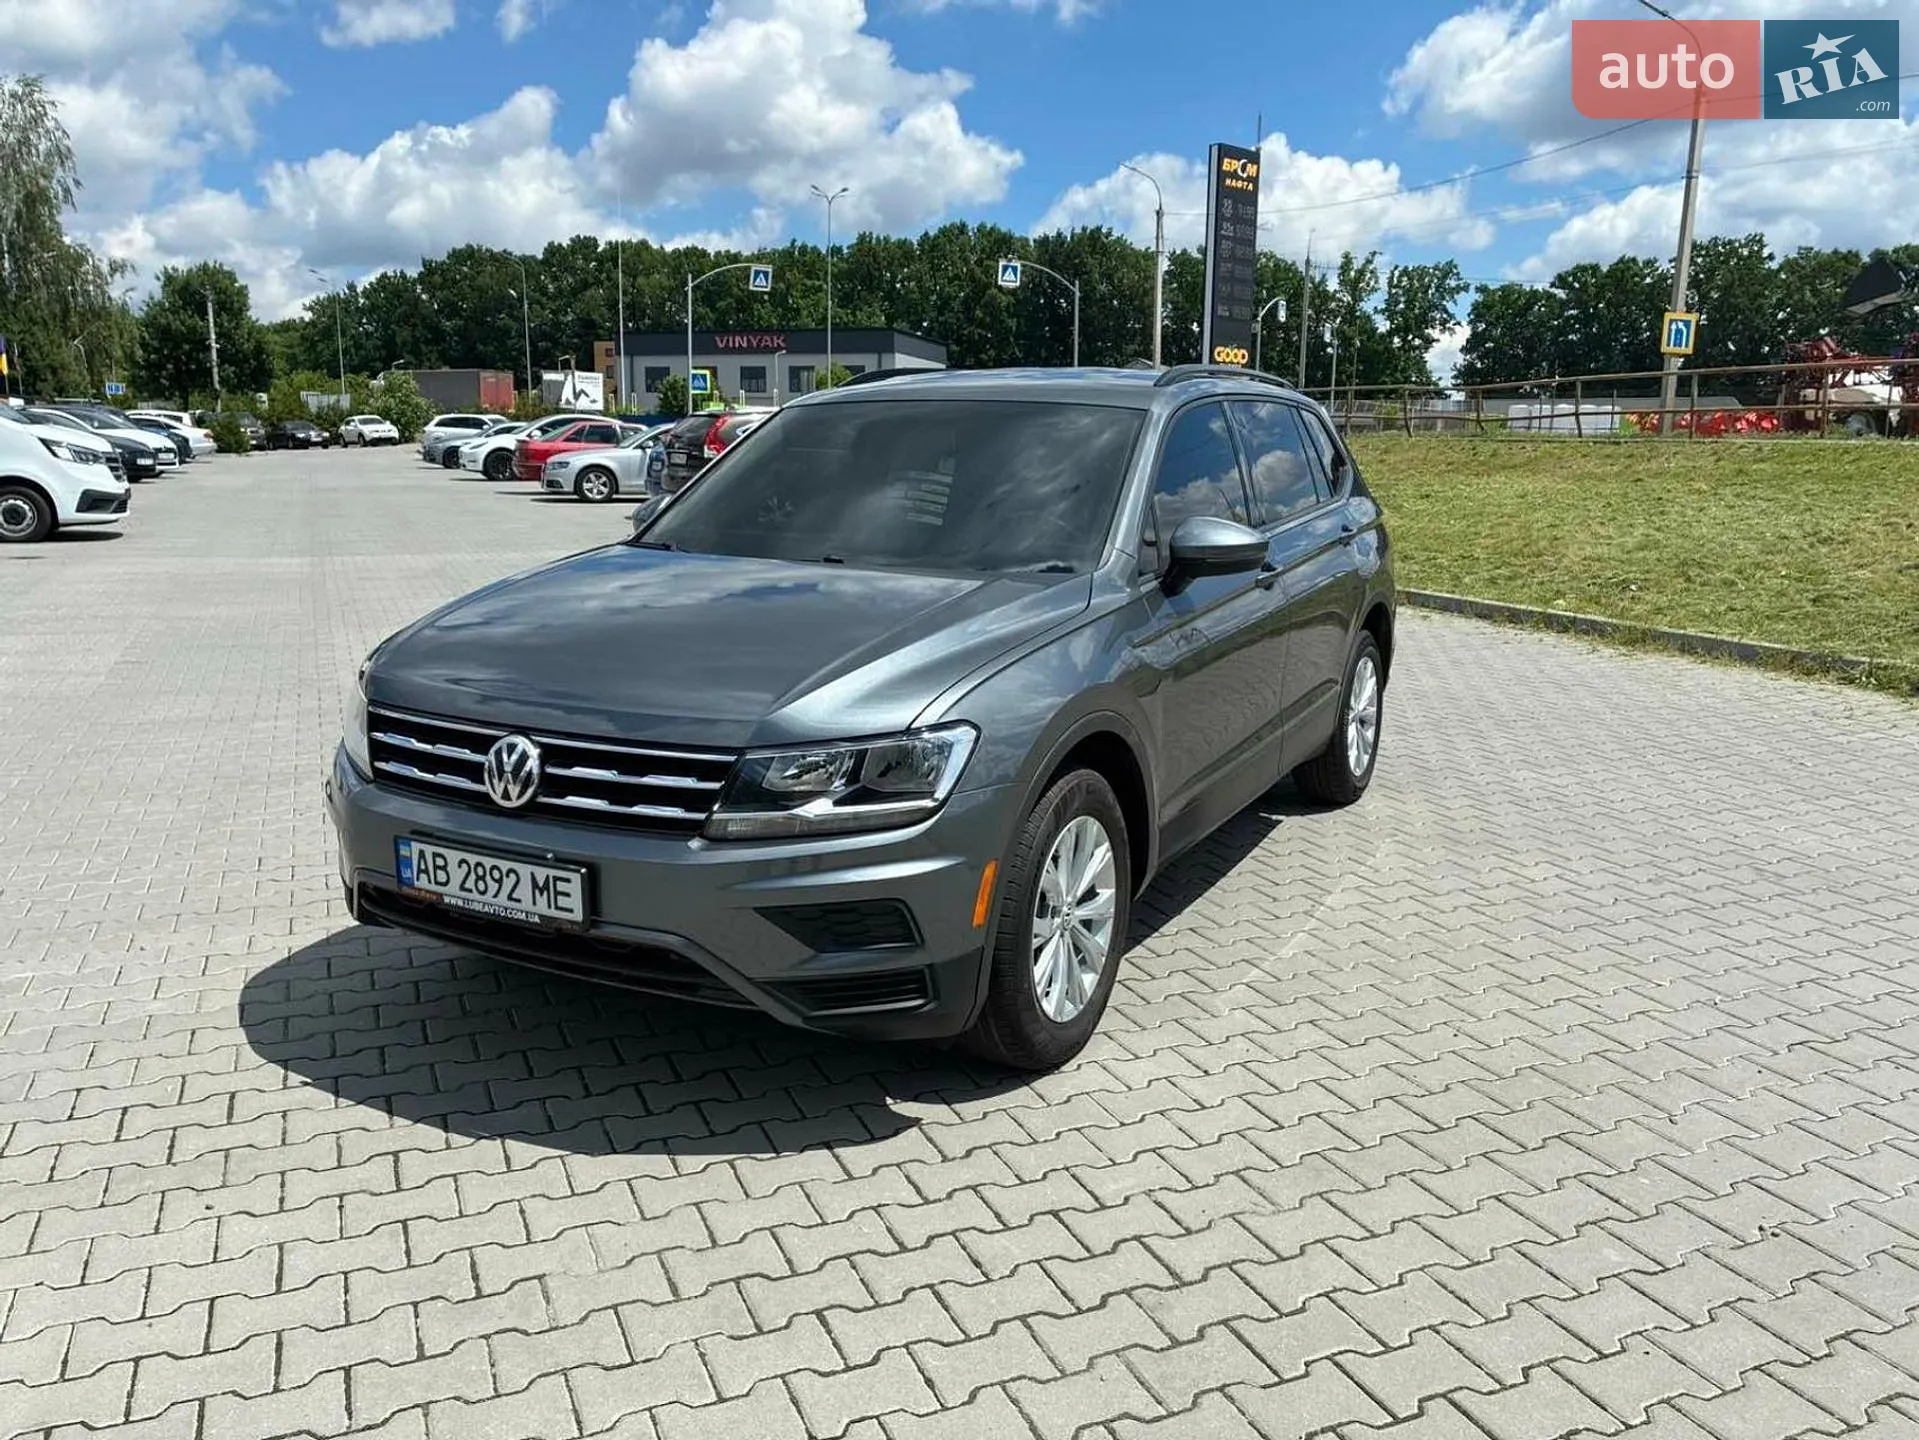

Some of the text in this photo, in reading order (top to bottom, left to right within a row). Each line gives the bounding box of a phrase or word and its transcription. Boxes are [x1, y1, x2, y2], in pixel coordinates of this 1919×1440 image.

[1225, 178, 1254, 192] НАФТА
[714, 335, 786, 348] VINYAK
[1214, 346, 1249, 364] GOOD
[416, 848, 575, 914] AB 2892 ME
